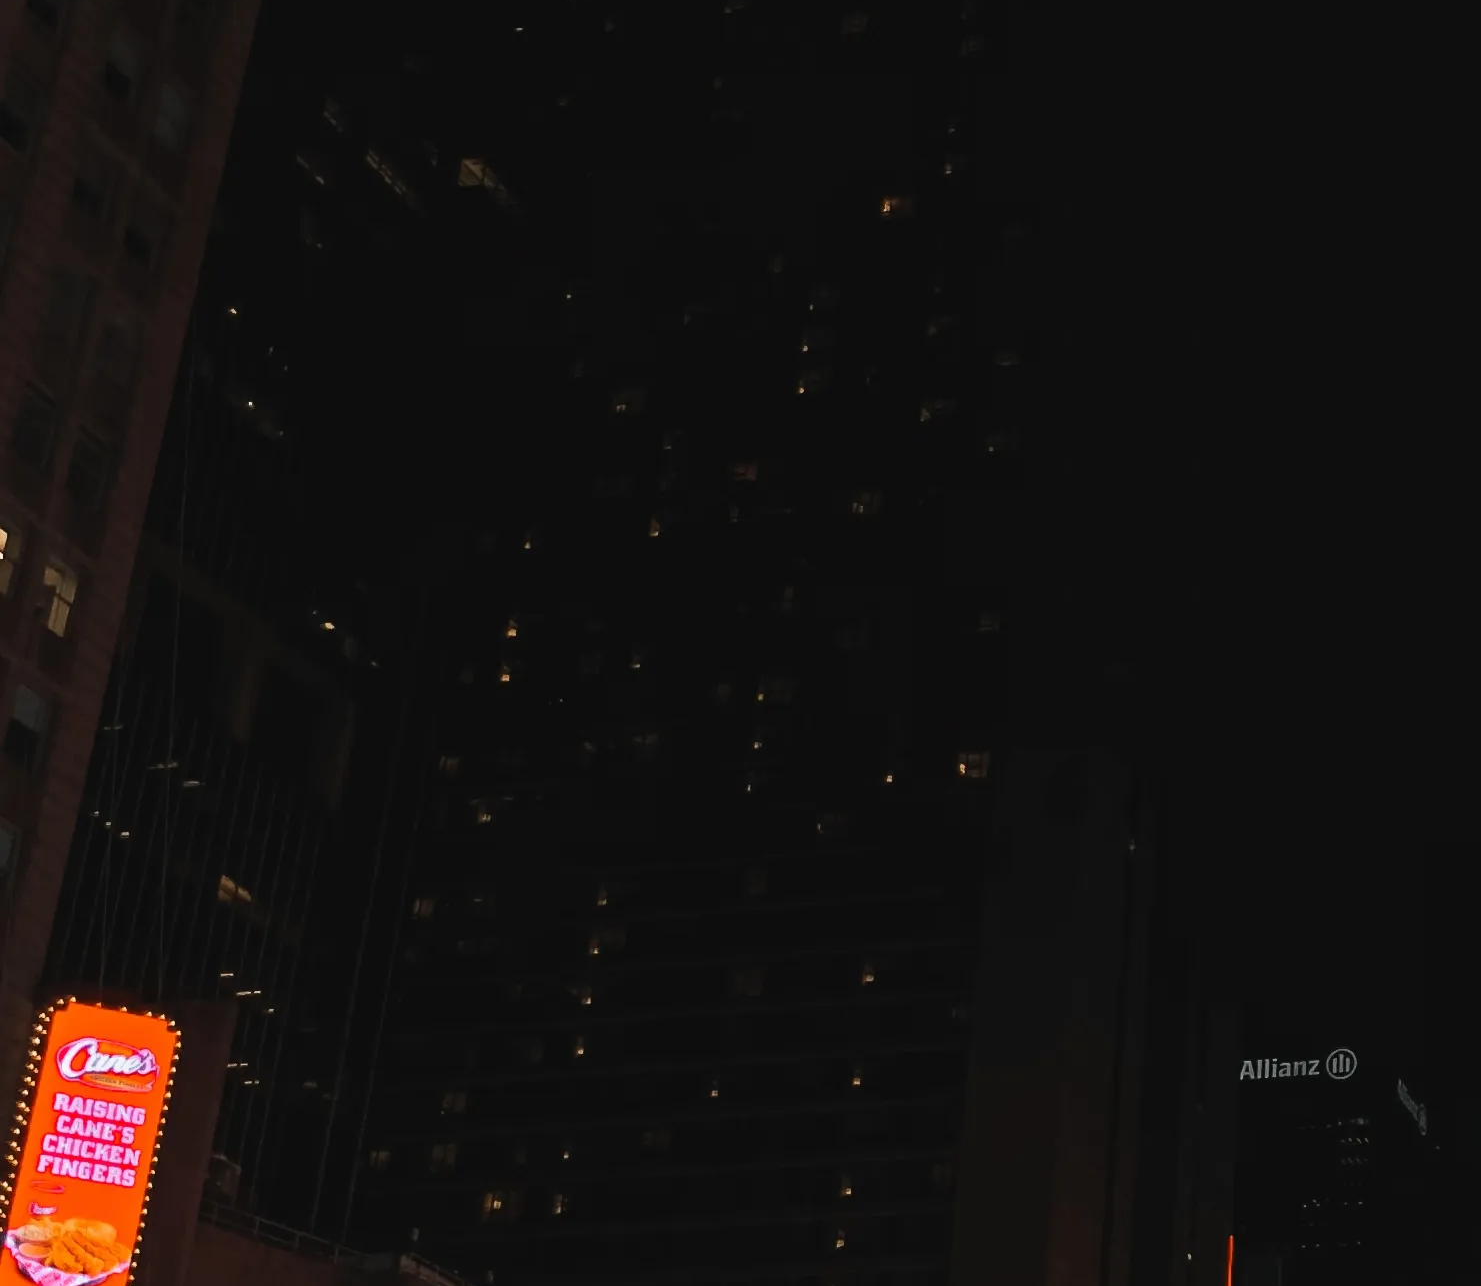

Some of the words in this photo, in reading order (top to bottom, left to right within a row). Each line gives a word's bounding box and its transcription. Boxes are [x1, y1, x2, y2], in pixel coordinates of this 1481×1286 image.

[1240, 1058, 1320, 1081] Allianz
[53, 1092, 146, 1125] RAISING
[56, 1114, 135, 1145] CANE'S
[42, 1134, 141, 1167] CHICKEN
[36, 1154, 136, 1187] FINGERS
